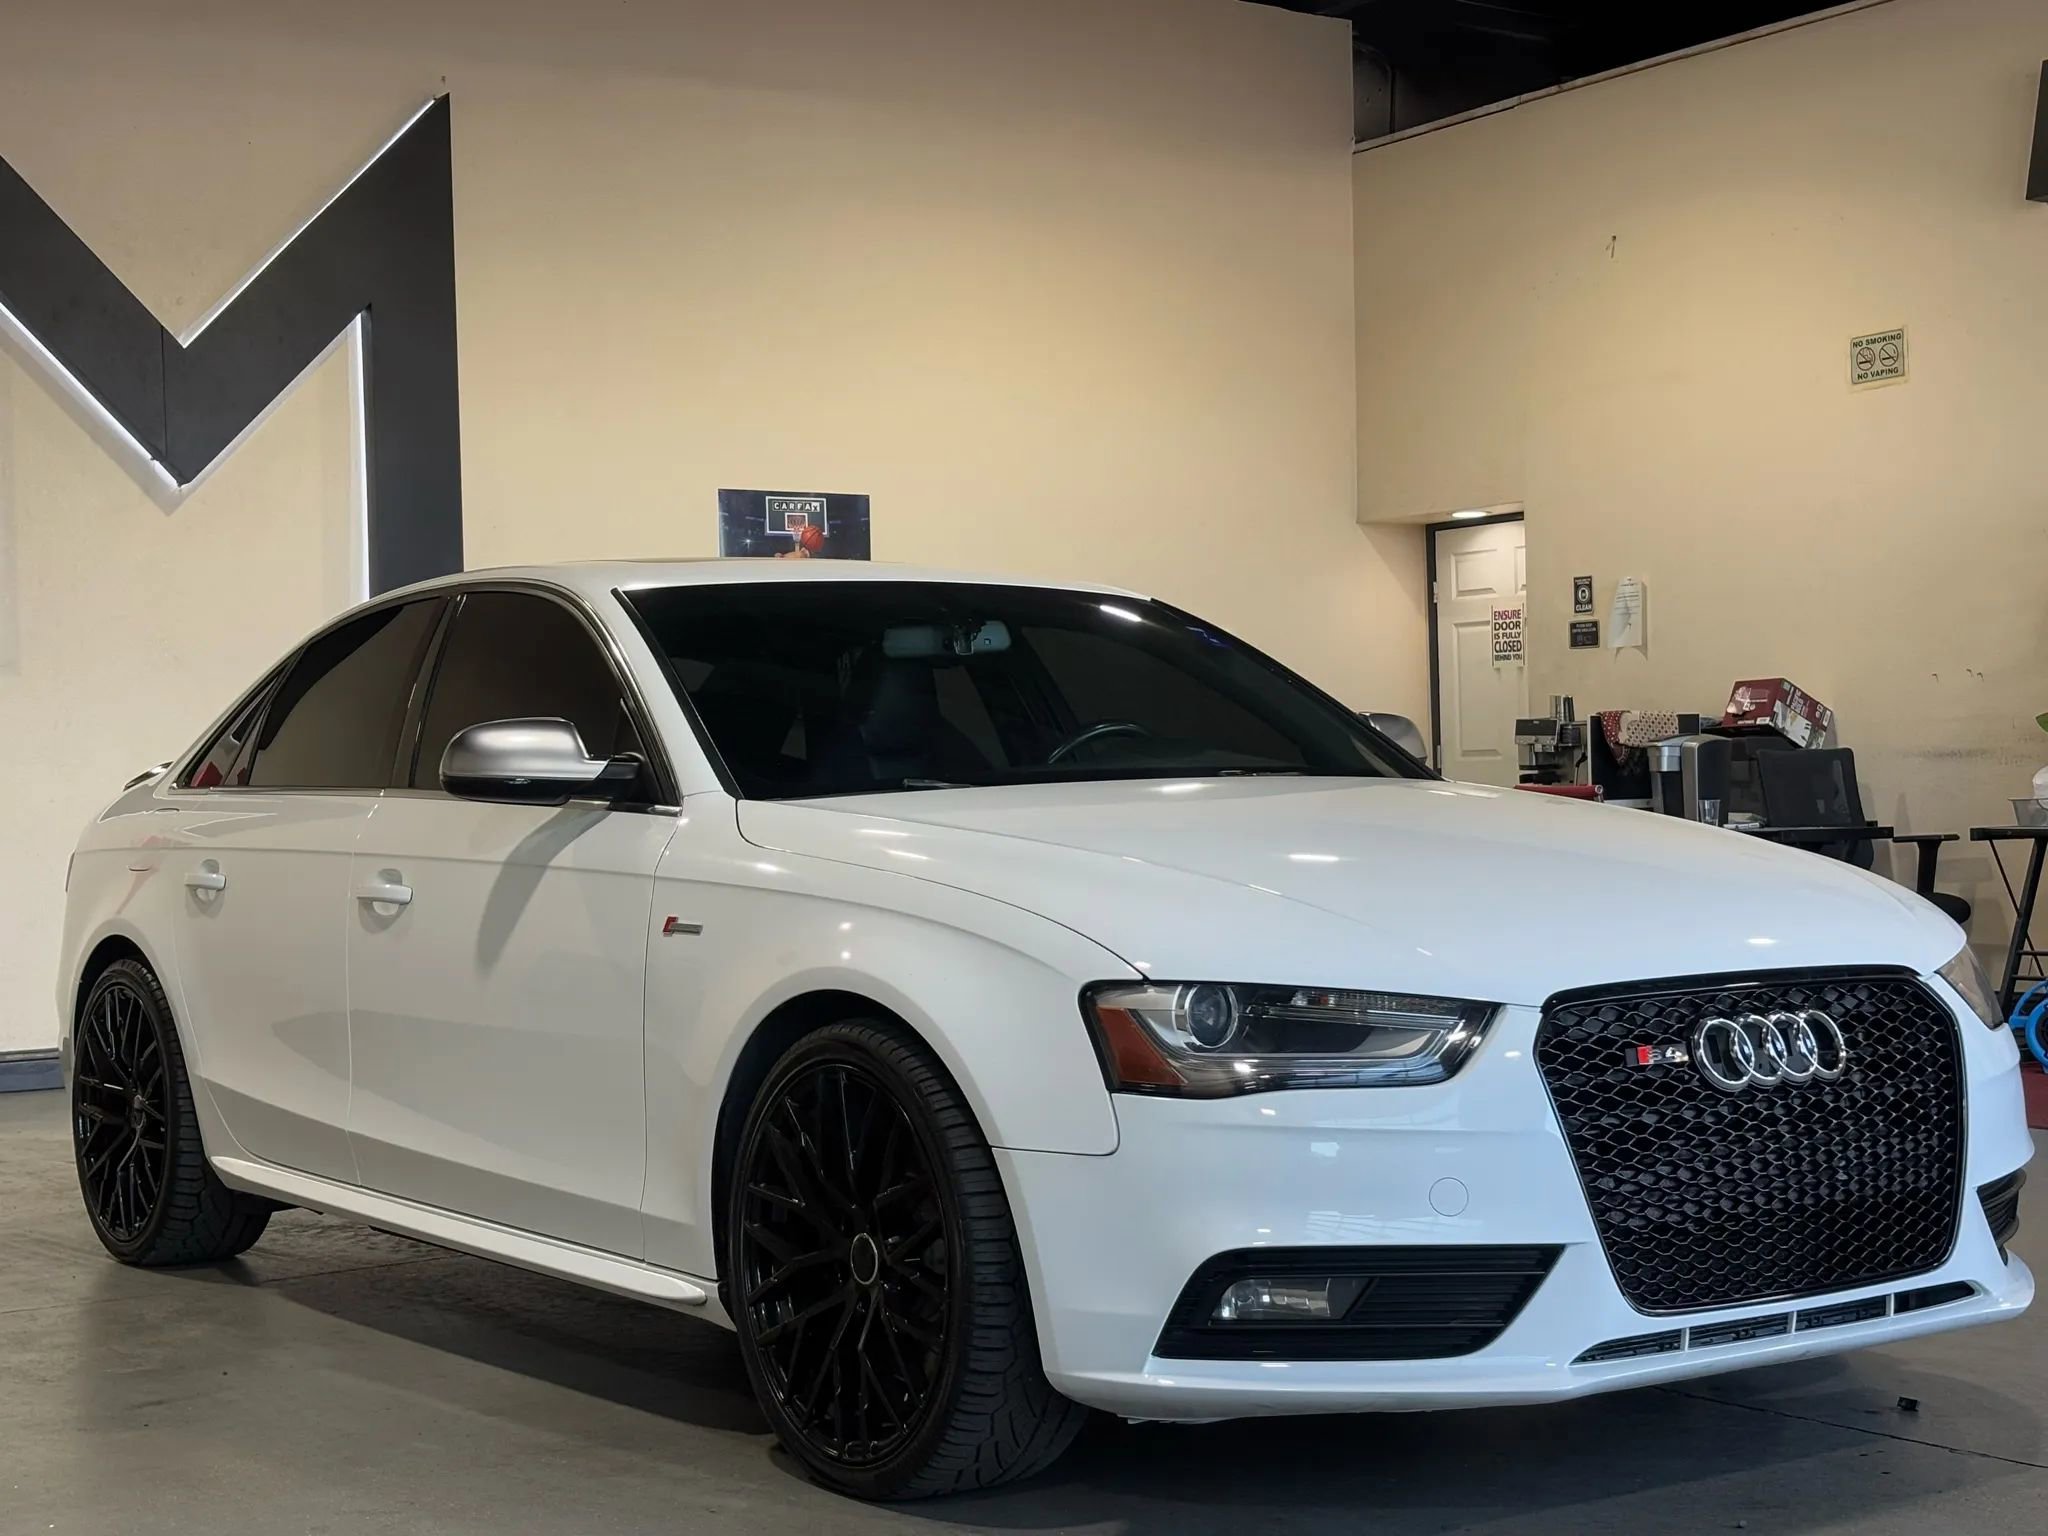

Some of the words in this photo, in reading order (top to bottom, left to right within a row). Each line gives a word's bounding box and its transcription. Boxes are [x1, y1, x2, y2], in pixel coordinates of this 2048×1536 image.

[1853, 340, 1863, 348] NO
[1866, 333, 1901, 346] SMOKING
[1857, 372, 1868, 380] NO
[1870, 366, 1899, 378] VAPING
[773, 501, 820, 512] CARFAX
[1493, 609, 1521, 620] ENSURE
[1494, 621, 1521, 631] DOOR
[1502, 632, 1521, 640] FULLY
[1494, 640, 1522, 653] CLOSED
